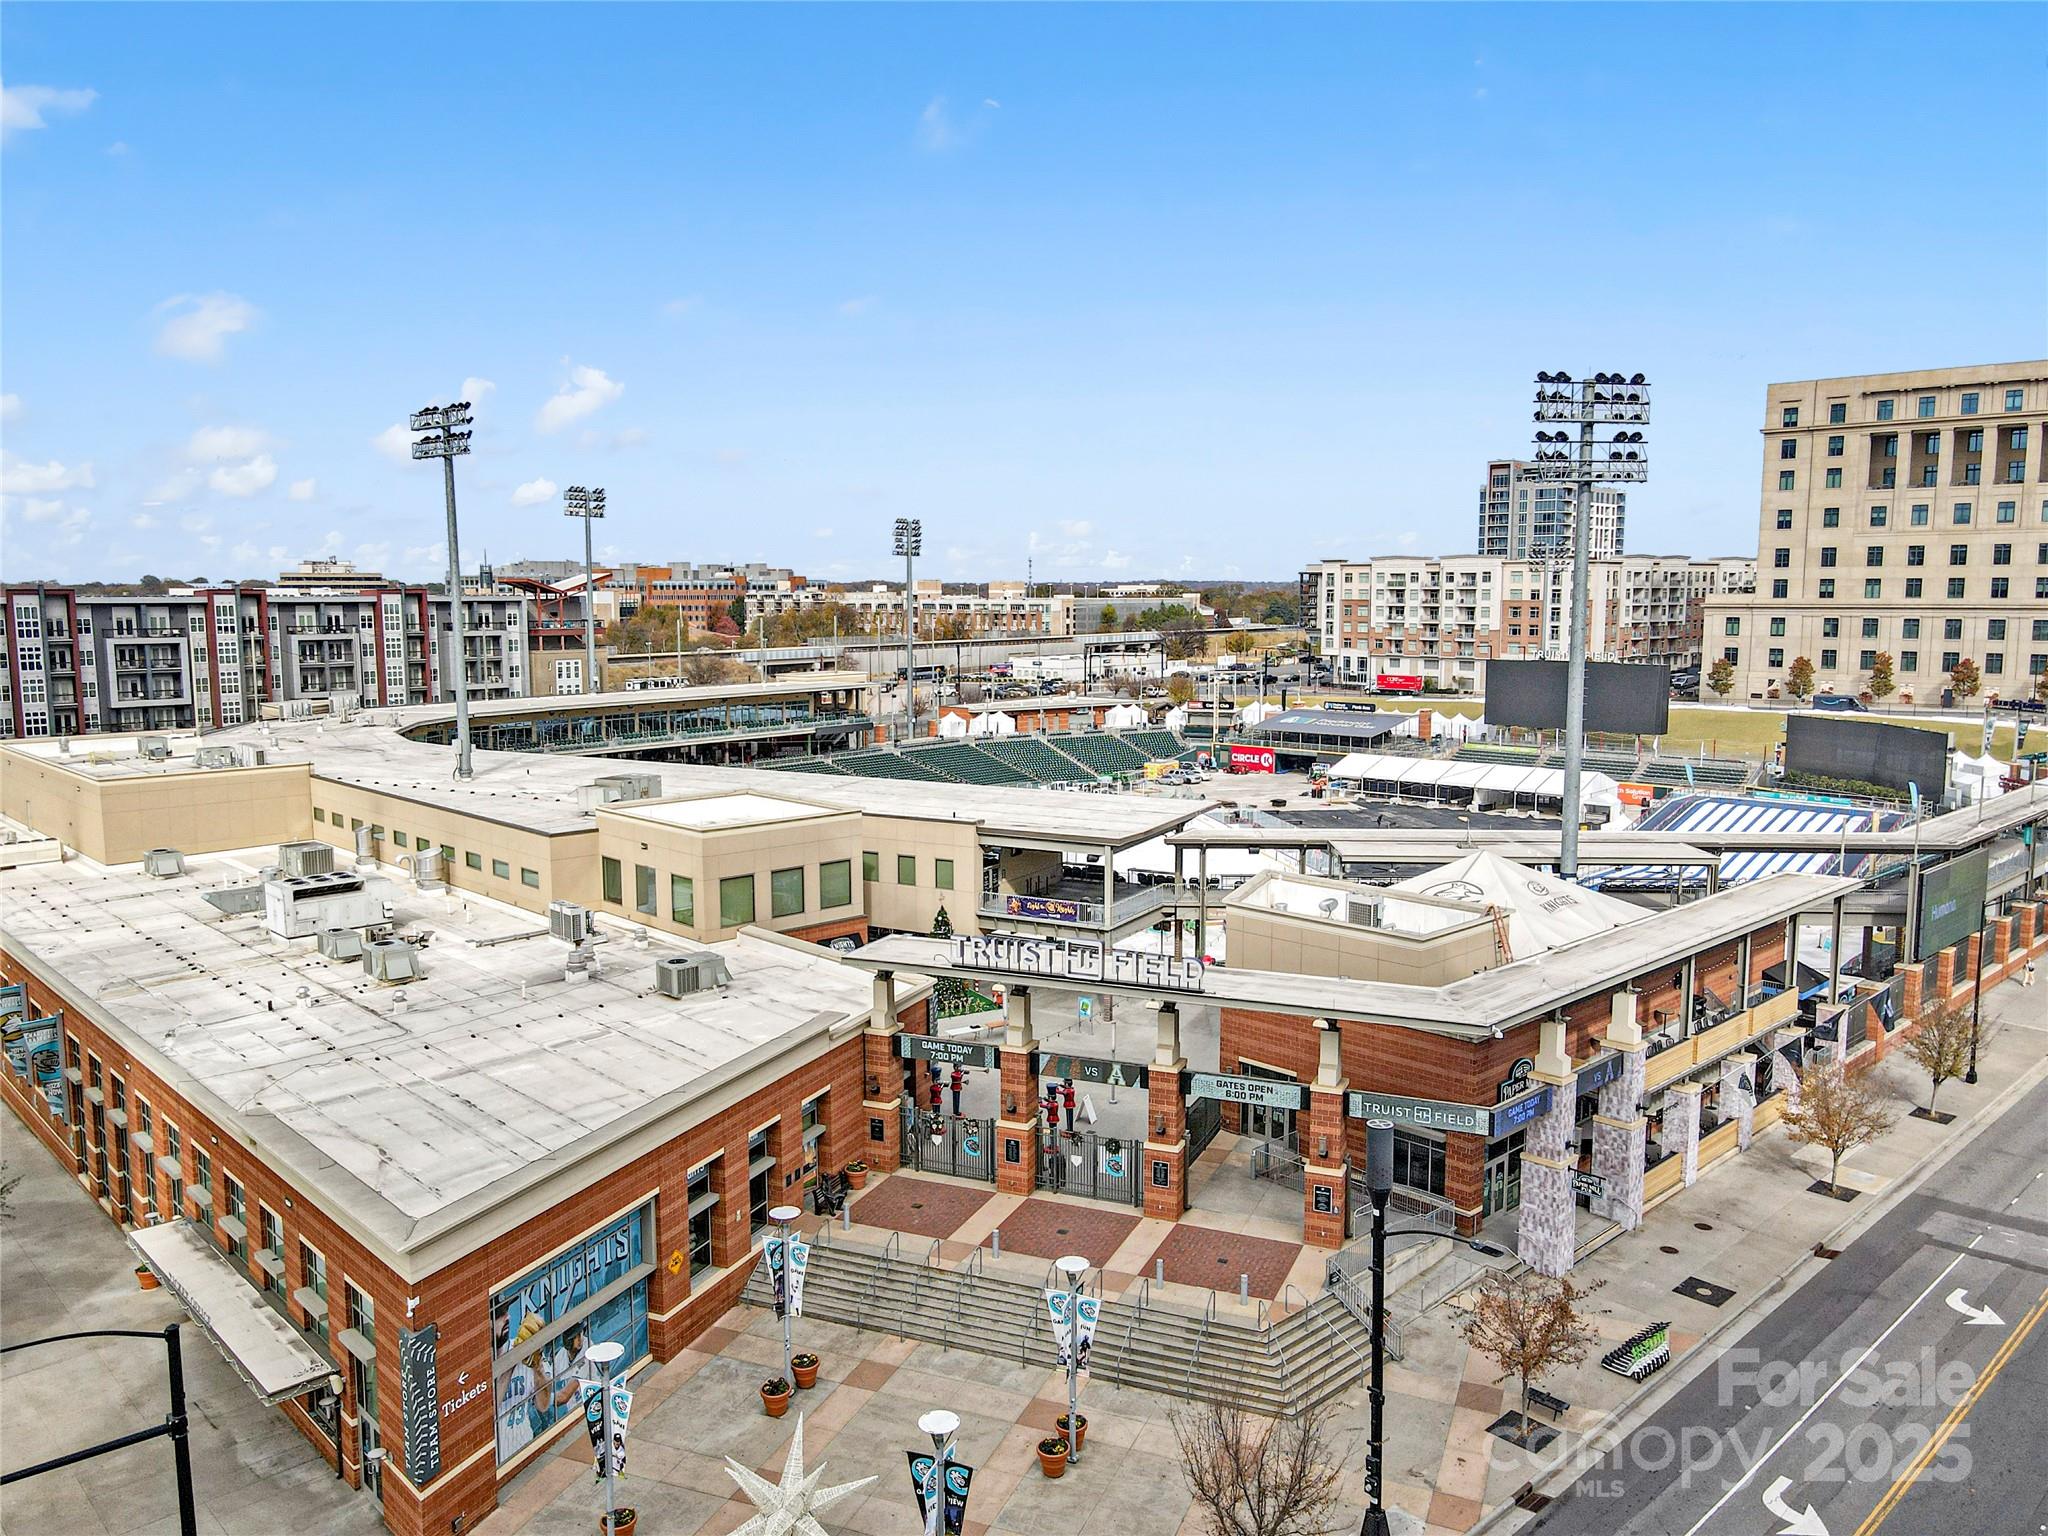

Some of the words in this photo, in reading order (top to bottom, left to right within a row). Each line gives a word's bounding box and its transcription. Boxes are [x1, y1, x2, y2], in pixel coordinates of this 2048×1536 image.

[1231, 753, 1260, 764] CIRCLE
[1540, 894, 1578, 913] KNIGHTS
[950, 935, 1059, 974] TRUIST
[1112, 950, 1206, 989] FIELD
[921, 1040, 946, 1052] GAME
[947, 1043, 973, 1055] TODAY
[930, 1051, 949, 1061] 7:00
[950, 1053, 964, 1063] PM
[1084, 1066, 1099, 1077] VS
[1216, 1079, 1245, 1092] GATES
[1248, 1083, 1274, 1095] OPEN
[1225, 1089, 1247, 1099] 6:00
[1249, 1092, 1264, 1102] PM
[1503, 1081, 1525, 1098] PAPER
[1363, 1101, 1412, 1118] TRUIST
[1434, 1111, 1474, 1127] FIELD
[1508, 1103, 1523, 1118] GAME
[1524, 1095, 1541, 1109] TODAY
[520, 1227, 629, 1316] KNIGHTS
[427, 1366, 437, 1419] STORE
[441, 1380, 488, 1418] Tickets
[430, 1422, 439, 1469] TEAM
